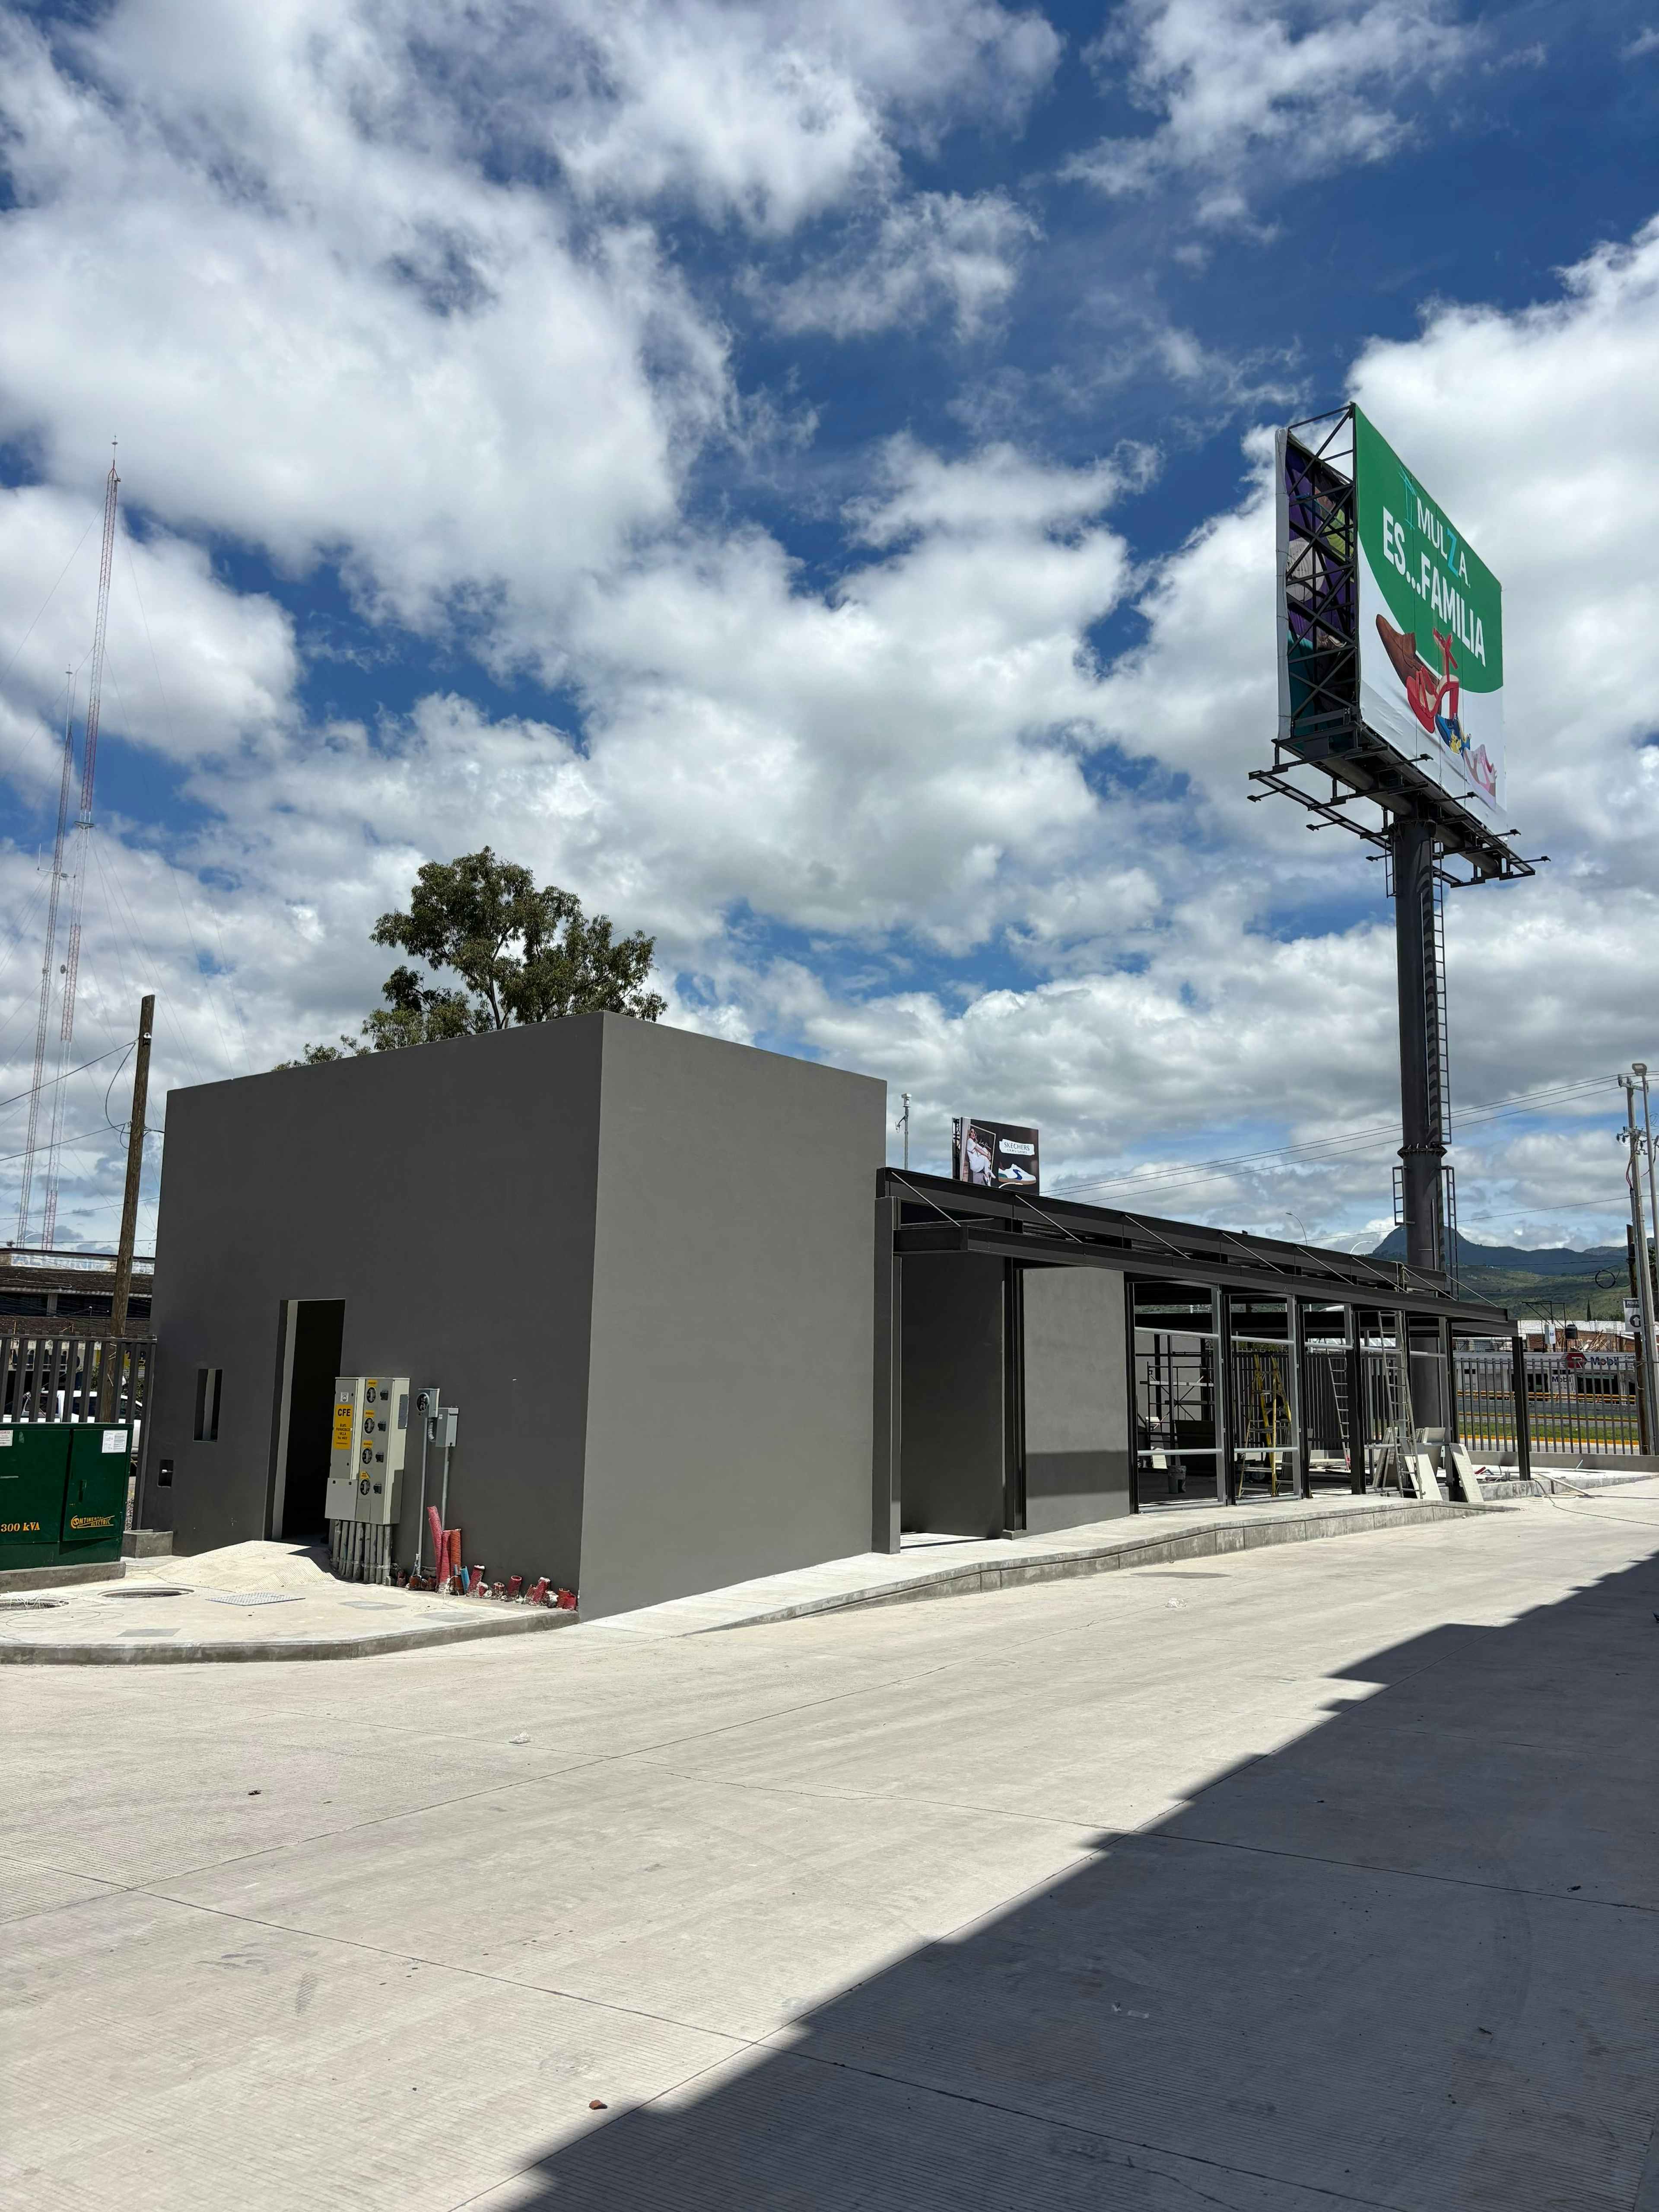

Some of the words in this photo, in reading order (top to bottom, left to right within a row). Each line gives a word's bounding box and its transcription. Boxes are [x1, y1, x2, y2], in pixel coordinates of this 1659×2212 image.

[1004, 1142, 1030, 1151] SKECHERS
[338, 1408, 351, 1417] CFE
[1, 1523, 20, 1532] 300
[23, 1522, 41, 1531] kVA
